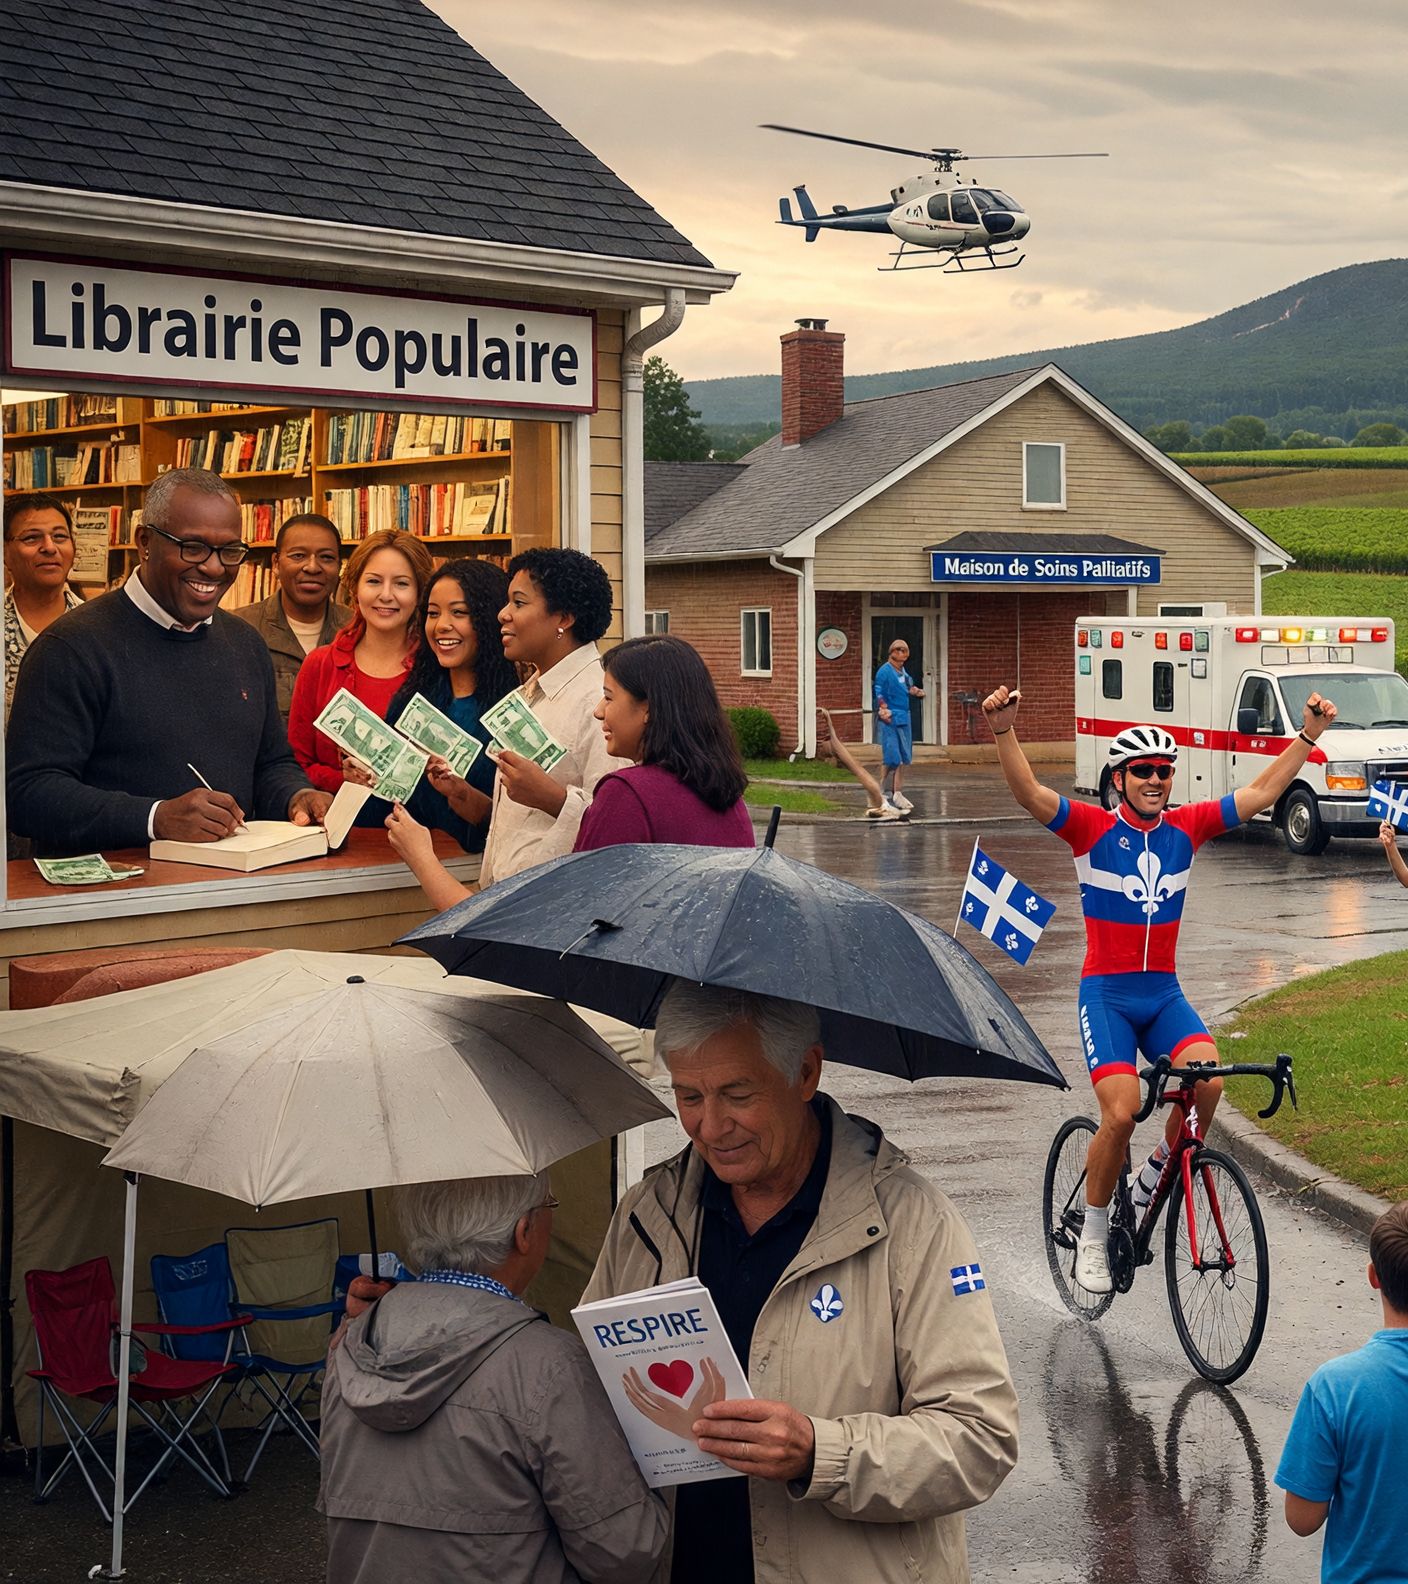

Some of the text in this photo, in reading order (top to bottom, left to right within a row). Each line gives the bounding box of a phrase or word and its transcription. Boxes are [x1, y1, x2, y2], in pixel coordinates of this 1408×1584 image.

[32, 280, 579, 388] Librairie Populaire
[944, 557, 1151, 578] Maison de Soins Palliatifs
[593, 1308, 708, 1348] RESPIRE
